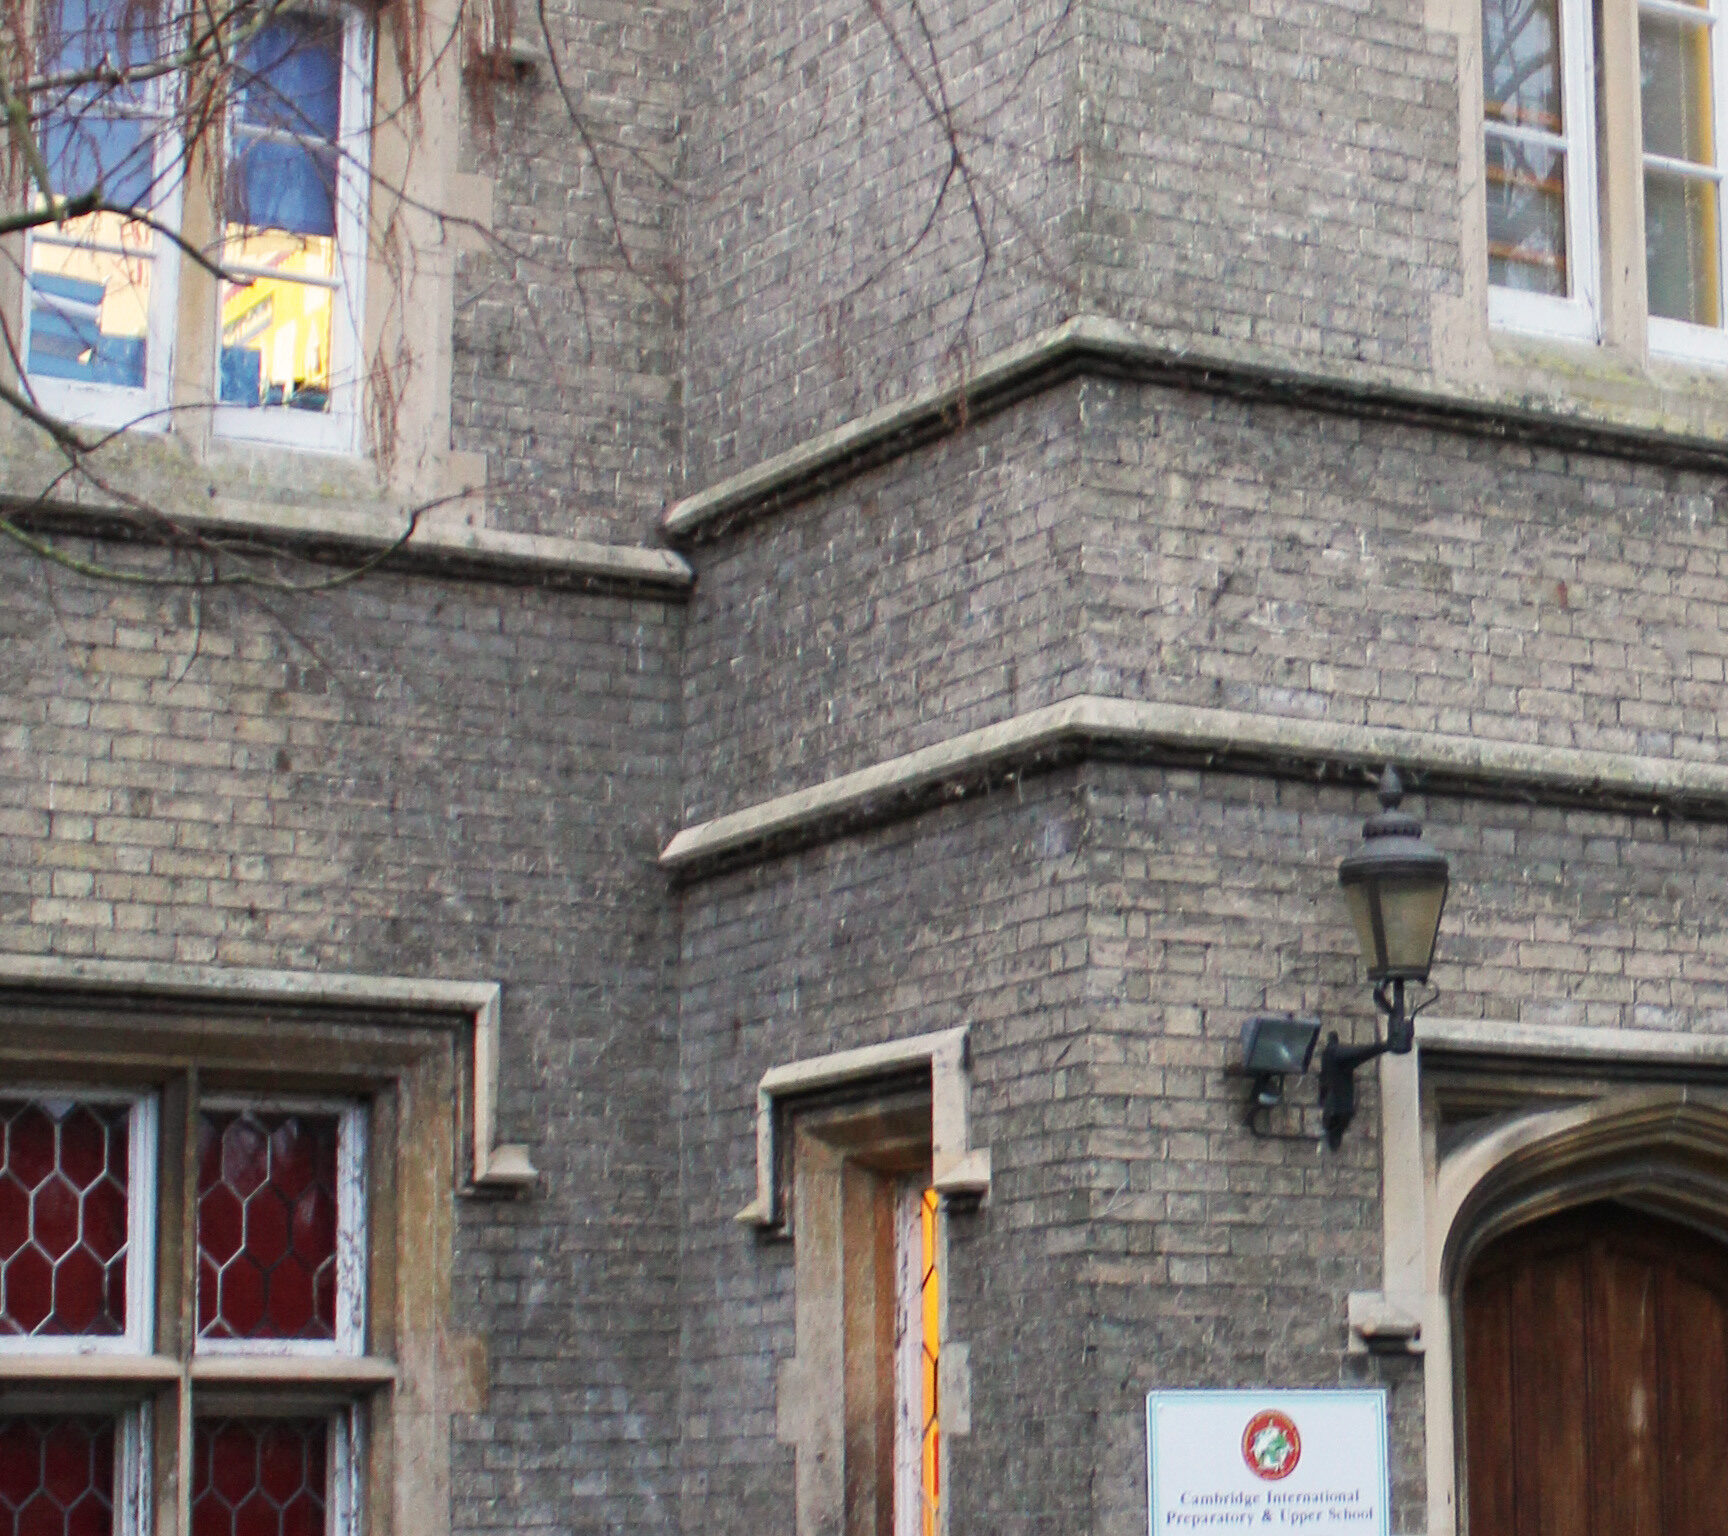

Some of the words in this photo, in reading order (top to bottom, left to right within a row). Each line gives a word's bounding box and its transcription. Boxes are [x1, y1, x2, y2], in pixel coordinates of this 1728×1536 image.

[1180, 1490, 1260, 1508] Cambridge
[1267, 1488, 1360, 1504] International
[1166, 1510, 1254, 1527] Preparatory
[1261, 1509, 1272, 1522] &
[1280, 1508, 1323, 1525] Upper
[1328, 1506, 1374, 1521] School
